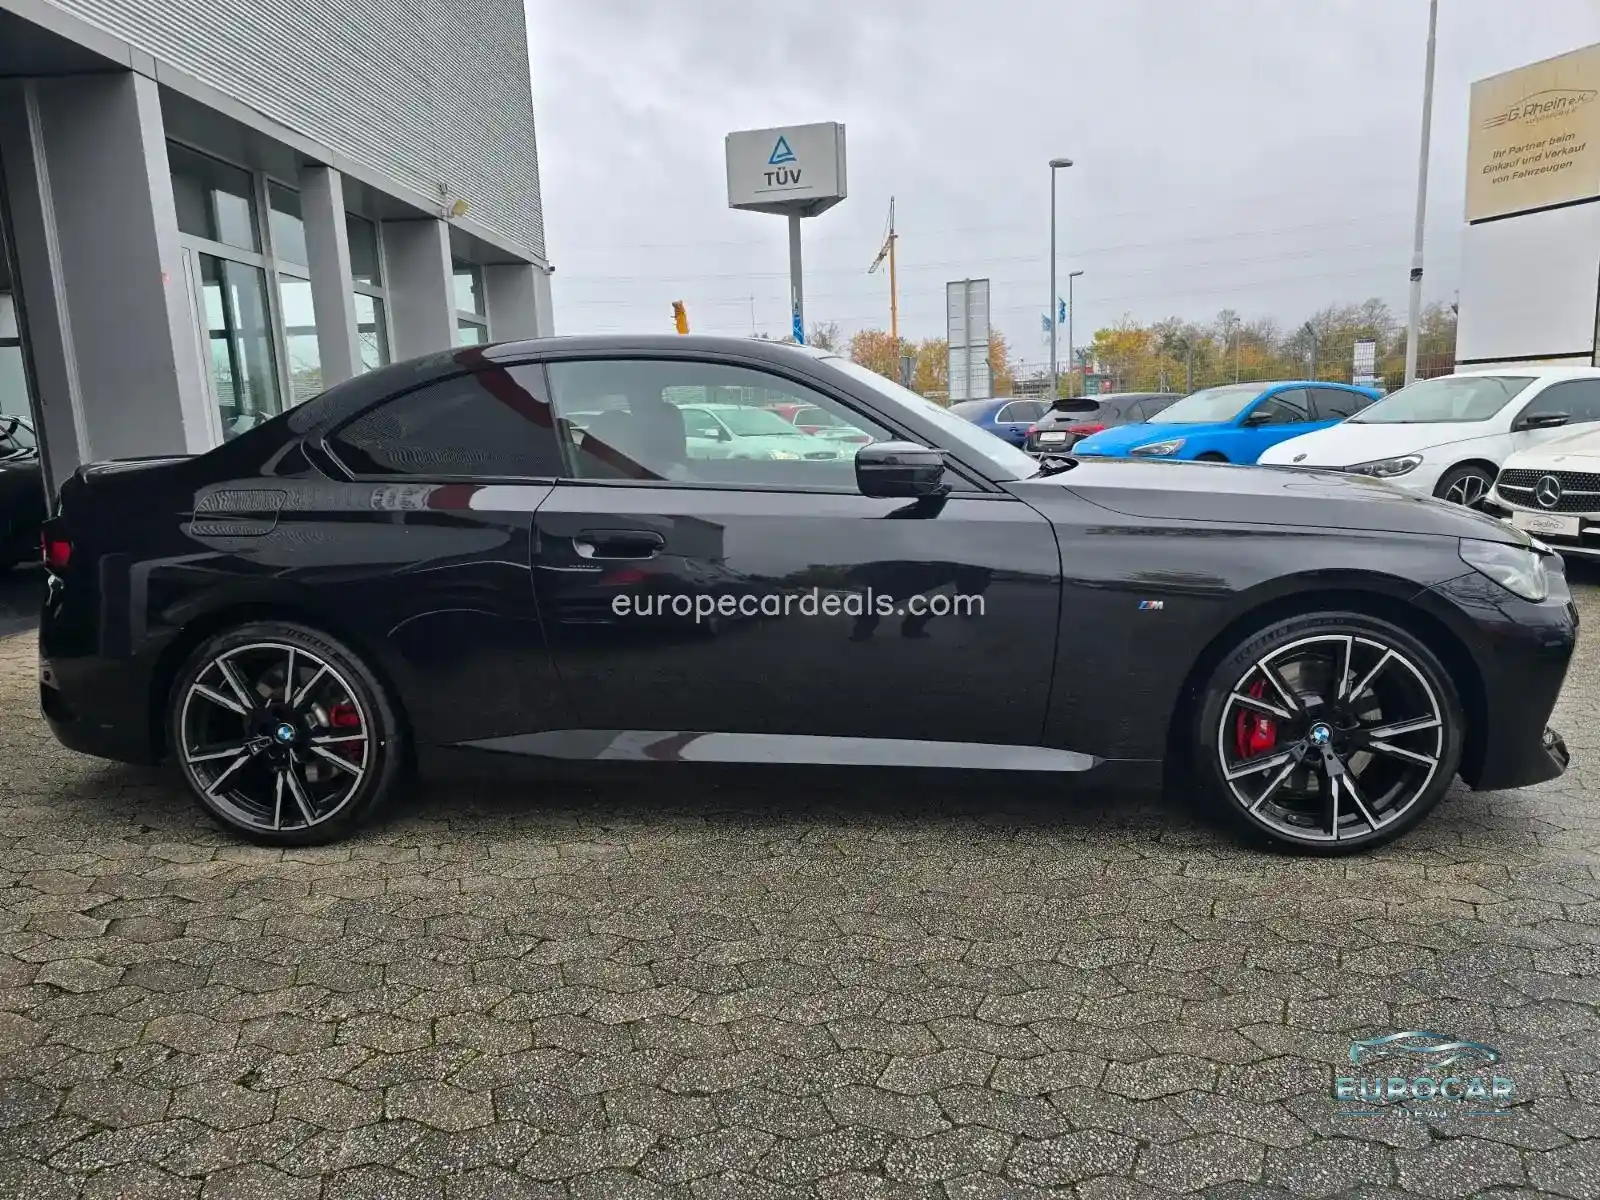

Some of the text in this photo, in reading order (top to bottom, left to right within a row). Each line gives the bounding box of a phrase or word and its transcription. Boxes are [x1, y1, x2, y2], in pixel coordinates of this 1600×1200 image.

[1482, 142, 1587, 174] Einkauf und Verkauf
[1492, 132, 1576, 159] Ihr Partner beim
[763, 166, 802, 186] TÜV
[1492, 161, 1573, 184] von Fahrzeugen
